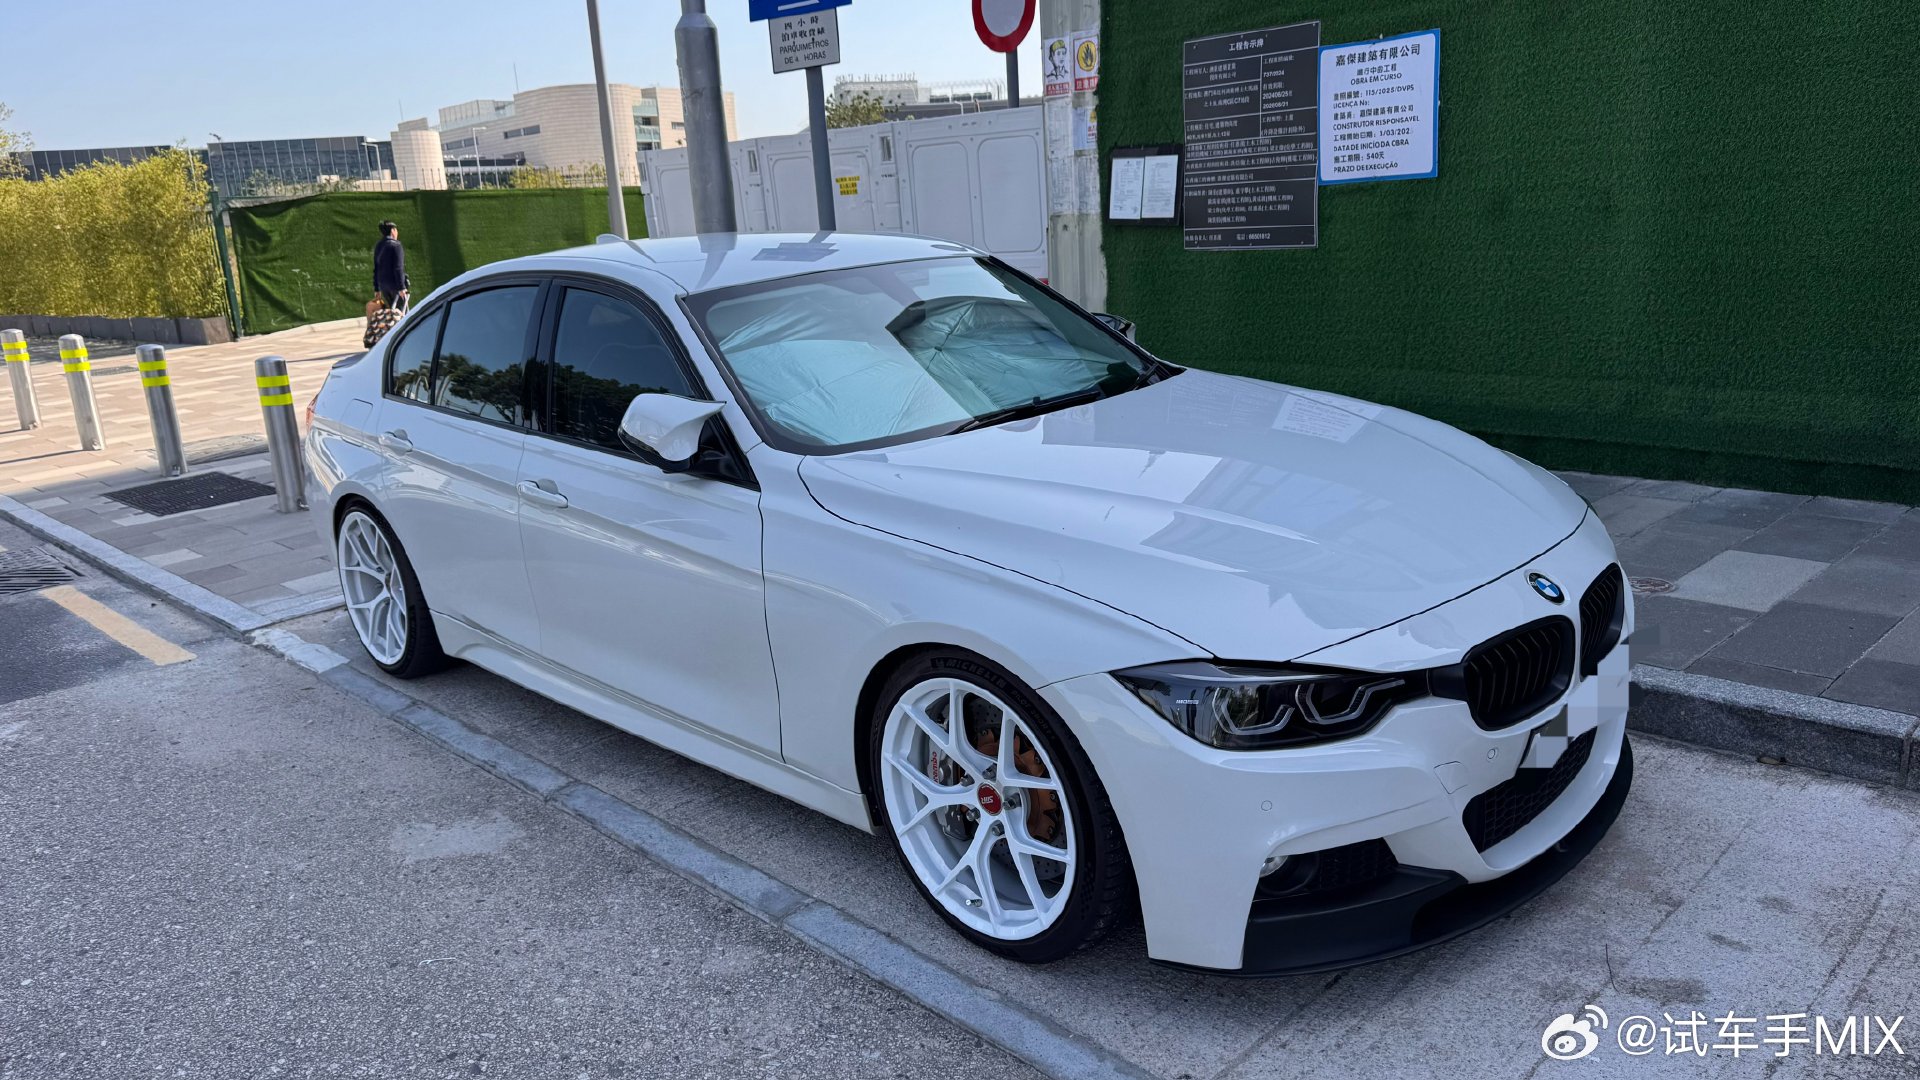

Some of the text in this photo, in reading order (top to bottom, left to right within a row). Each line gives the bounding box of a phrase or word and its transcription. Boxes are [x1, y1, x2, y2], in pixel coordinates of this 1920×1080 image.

[1229, 39, 1264, 52] 工程告示牌
[804, 51, 826, 61] HORAS
[1336, 44, 1420, 66] 嘉傑建築有限公司
[1351, 77, 1367, 85] OBRA
[1334, 101, 1358, 109] LICENÇA
[1333, 120, 1374, 130] CONSTRUTOR
[1366, 151, 1385, 160] 540天
[1334, 165, 1355, 173] PRAZO
[946, 659, 1006, 689] MICHELIN
